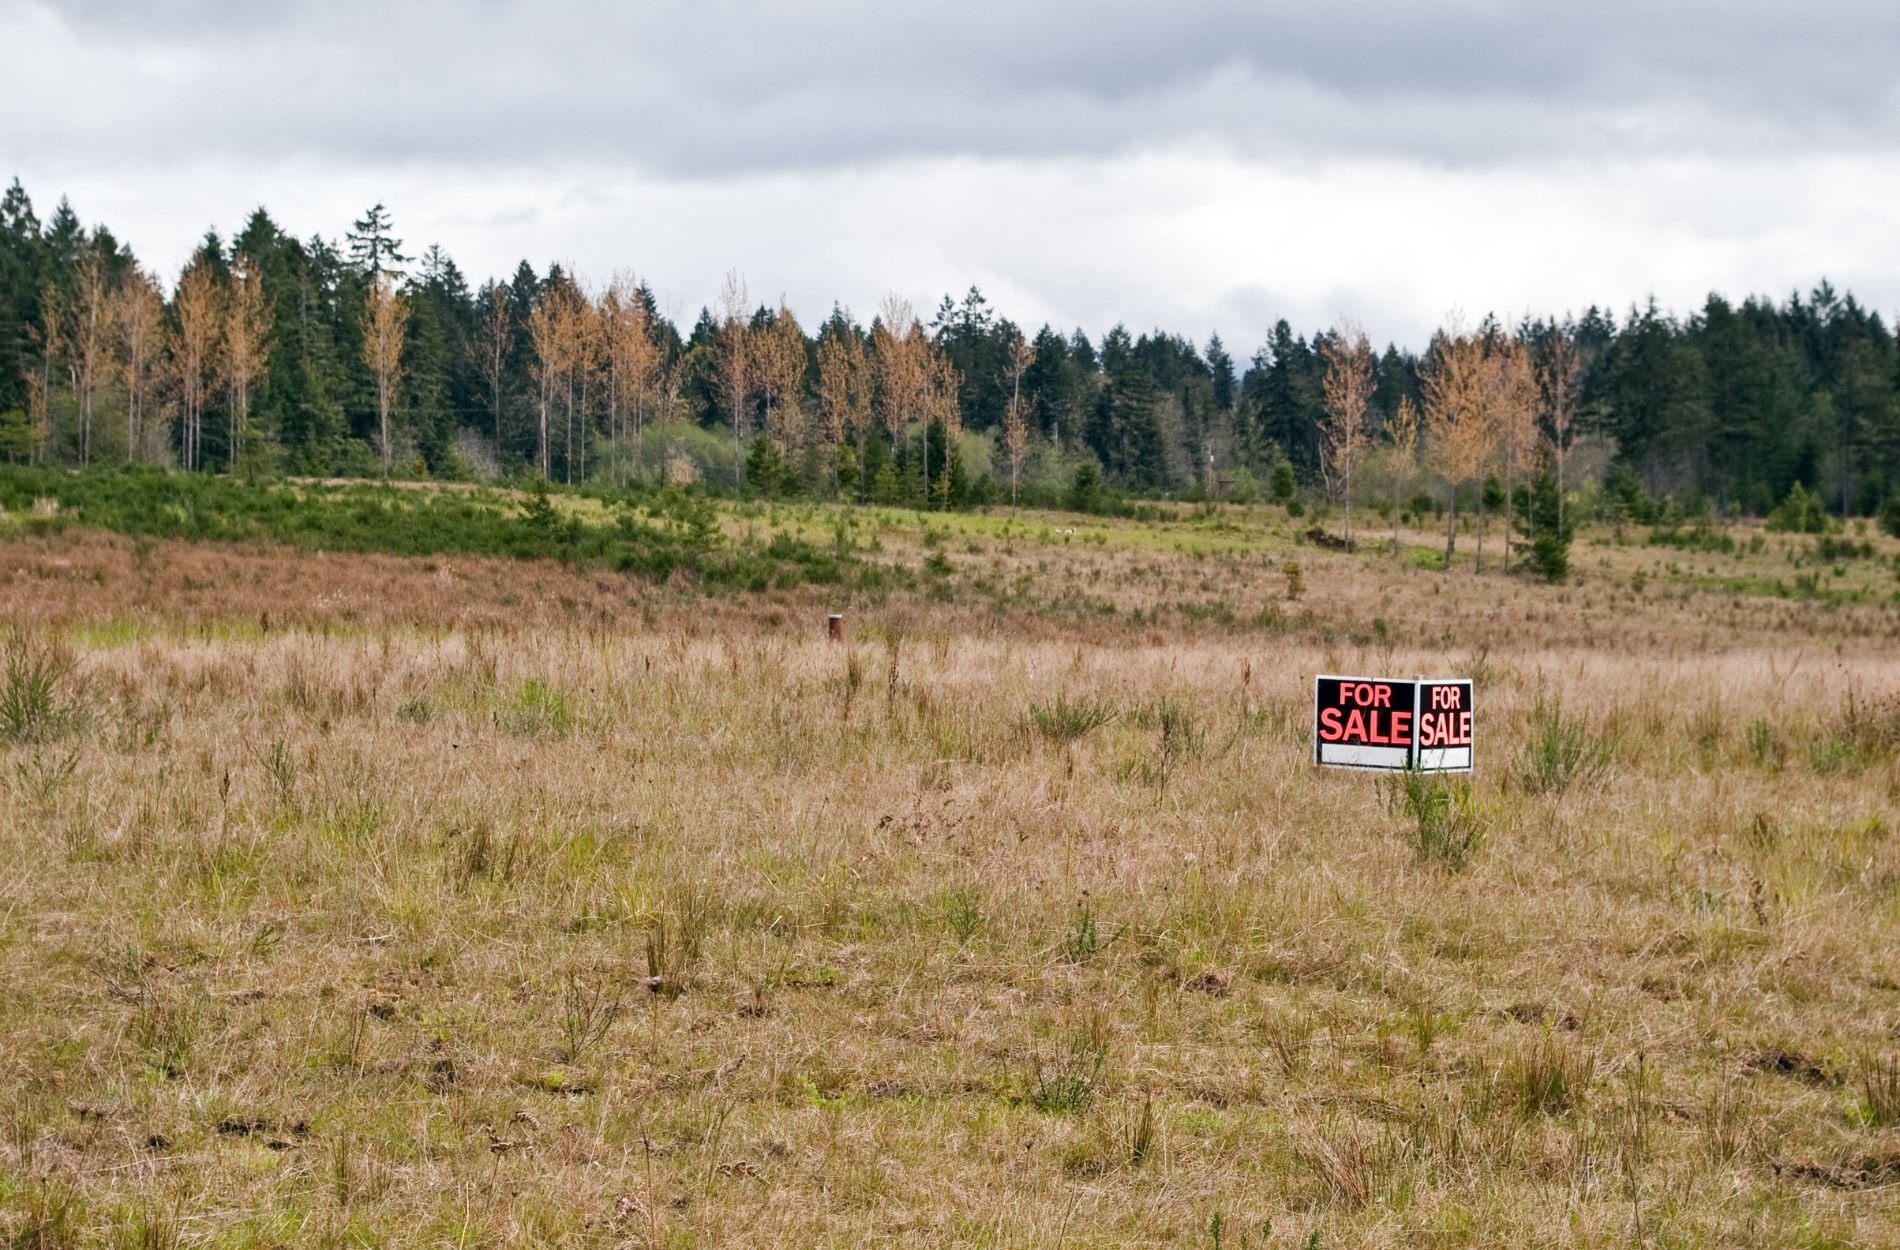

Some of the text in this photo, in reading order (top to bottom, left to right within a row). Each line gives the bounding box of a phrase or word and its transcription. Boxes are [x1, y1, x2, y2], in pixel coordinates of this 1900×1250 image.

[1339, 682, 1391, 708] FOR
[1432, 686, 1461, 709] FOR
[1319, 707, 1412, 745] SALE
[1419, 711, 1472, 746] SALE
